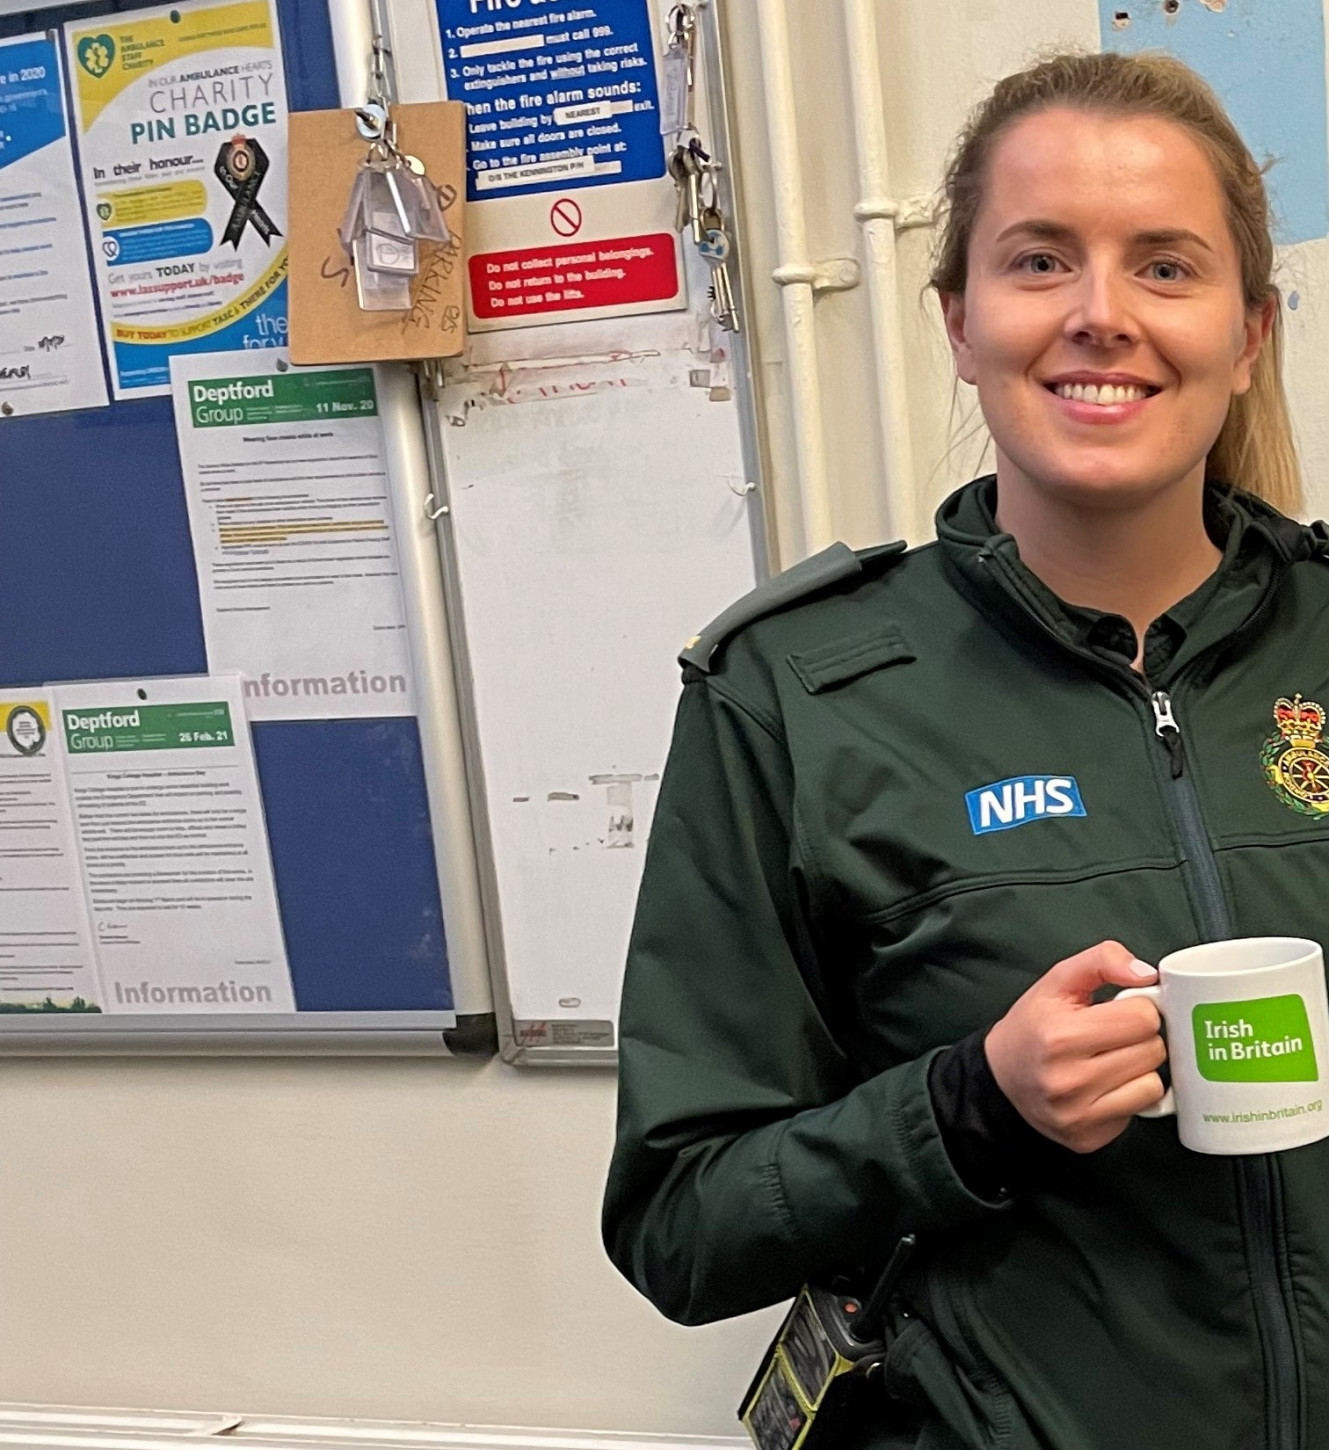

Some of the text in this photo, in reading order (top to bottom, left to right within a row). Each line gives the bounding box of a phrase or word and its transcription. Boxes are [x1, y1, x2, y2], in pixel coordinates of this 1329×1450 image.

[456, 24, 494, 38] Operate
[496, 20, 510, 31] the
[513, 15, 548, 29] nearest
[549, 12, 565, 24] fire
[546, 32, 570, 44] must
[572, 29, 590, 40] call
[462, 65, 484, 78] Only
[487, 60, 516, 73] tackle
[518, 58, 534, 69] the
[537, 55, 553, 66] fire
[555, 52, 582, 65] using
[585, 48, 600, 59] the
[603, 43, 638, 56] correct
[180, 66, 238, 82] AMBULANCE
[464, 74, 526, 90] extinguishers
[529, 69, 547, 81] and
[549, 65, 585, 80] without
[588, 61, 618, 74] taking
[150, 73, 273, 113] CHARITY
[466, 81, 641, 115] hen the fire alarm sounds:
[131, 102, 276, 144] PIN BADGE
[469, 121, 496, 134] Leave
[500, 116, 538, 130] building
[540, 114, 552, 125] by
[565, 107, 600, 119] NEAREST
[471, 140, 496, 151] Make
[500, 138, 520, 147] sure
[523, 134, 535, 145] all
[538, 131, 565, 142] doors
[569, 129, 584, 139] are
[473, 159, 487, 170] Go
[490, 158, 499, 168] to
[503, 155, 517, 165] the
[521, 154, 536, 163] fire
[540, 148, 584, 162] assembly
[587, 144, 611, 155] point
[94, 168, 105, 179] In
[114, 162, 141, 175] their
[504, 170, 517, 180] THE
[520, 165, 568, 178] KENNINGTON
[156, 264, 195, 278] TODAY
[487, 263, 500, 273] Do
[503, 261, 519, 272] not
[522, 258, 552, 270] collect
[555, 252, 596, 268] personal
[489, 281, 502, 290] Do
[505, 279, 521, 289] not
[524, 276, 552, 287] return
[554, 274, 564, 283] to
[567, 273, 582, 282] the
[491, 298, 504, 308] Do
[508, 296, 523, 305] not
[526, 294, 543, 304] use
[546, 292, 561, 302] the
[193, 380, 274, 405] Deptford
[196, 406, 243, 424] Group
[317, 400, 374, 413] 11 Nov. 20
[243, 670, 406, 698] nformation
[67, 710, 140, 732] Deptford
[71, 733, 113, 750] Group
[216, 731, 228, 740] 21
[980, 778, 1074, 827] NHS
[114, 981, 272, 1004] Information
[1204, 1019, 1253, 1038] Irish
[1208, 1036, 1302, 1060] in Britain
[1202, 1100, 1322, 1123] www.irishinbritain.org
